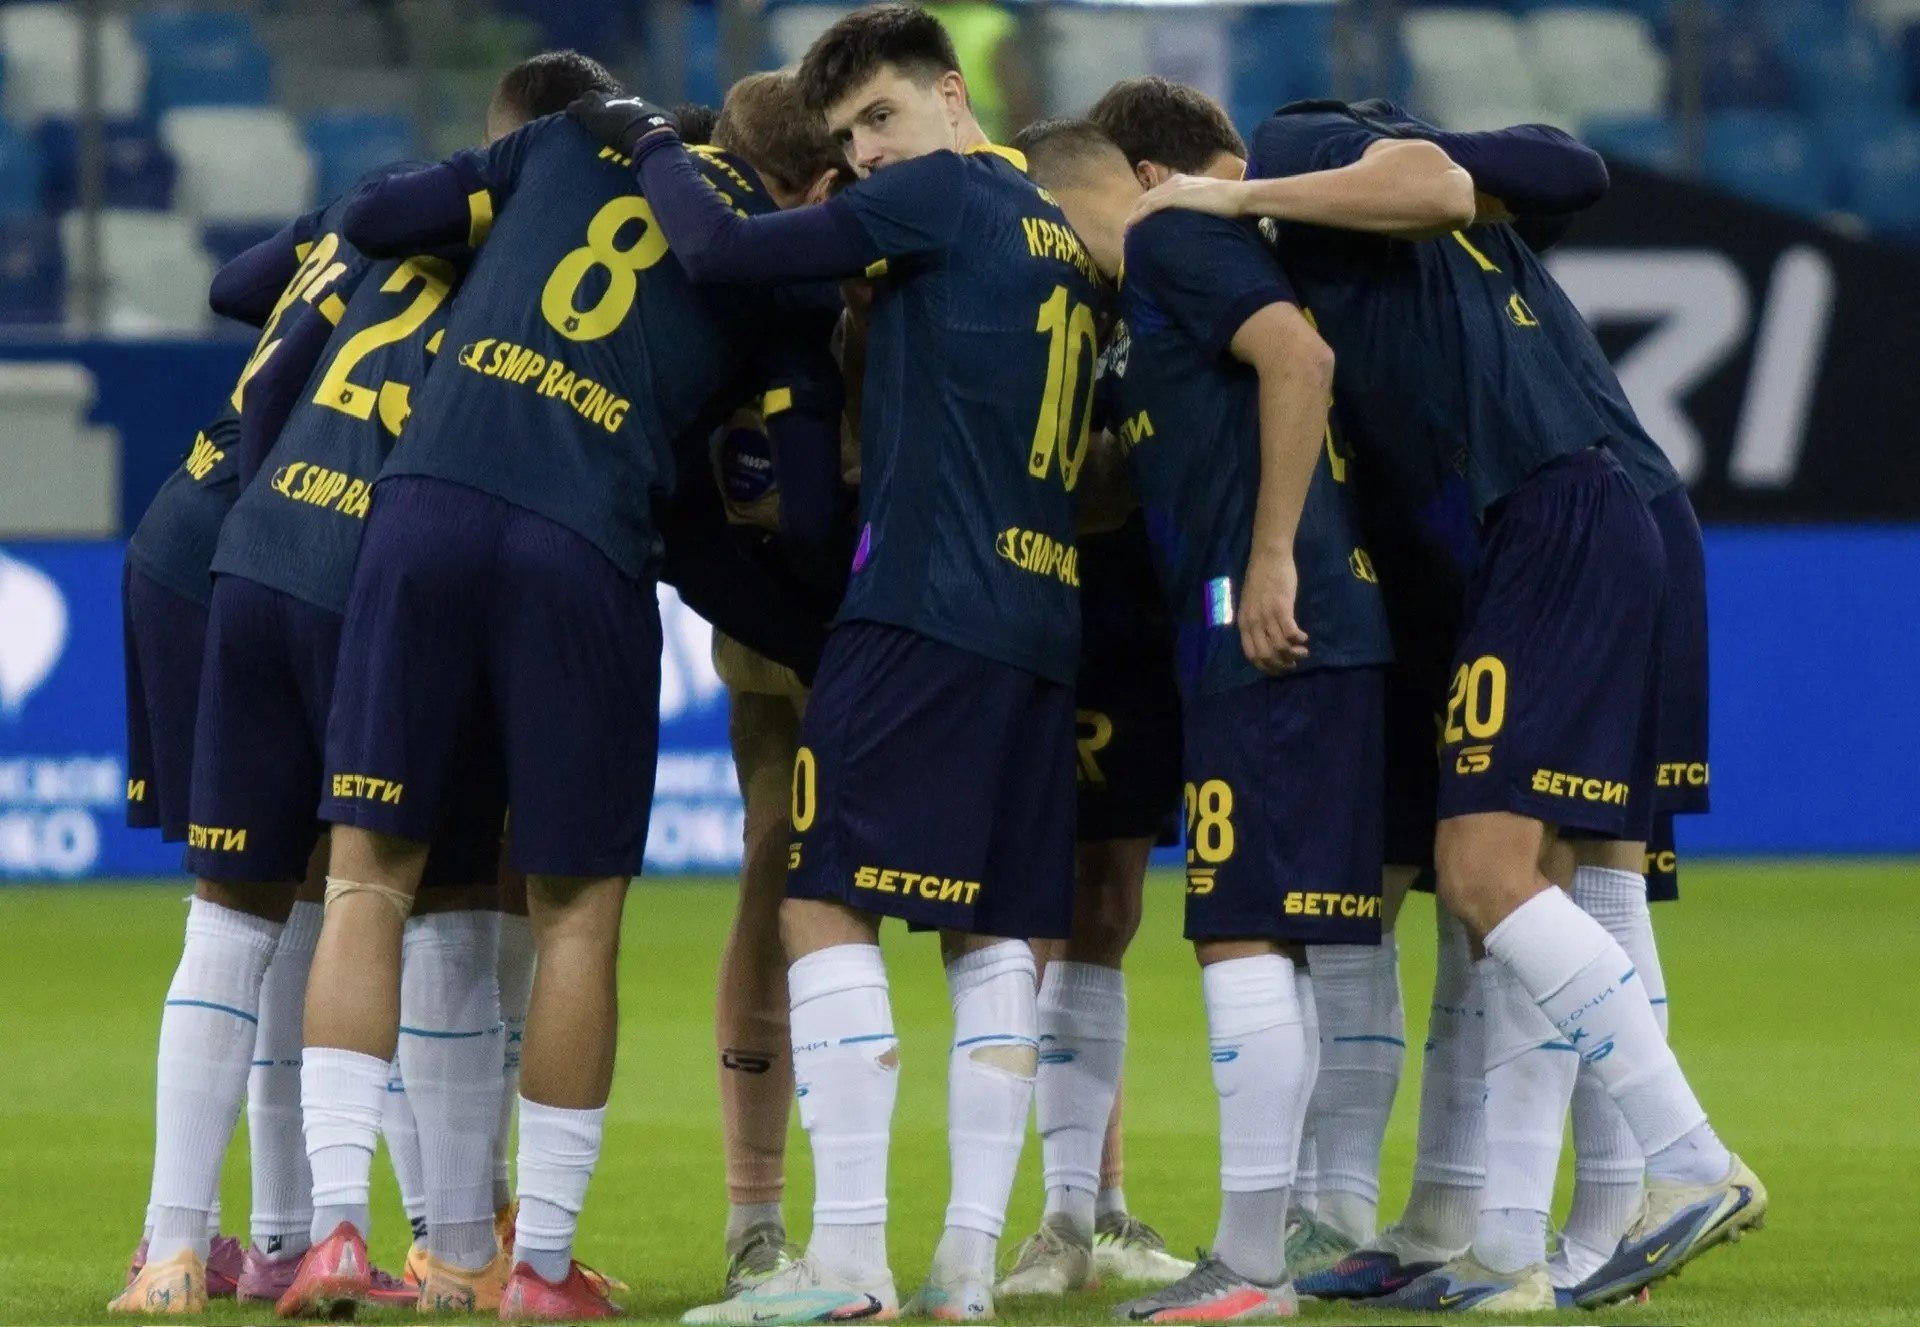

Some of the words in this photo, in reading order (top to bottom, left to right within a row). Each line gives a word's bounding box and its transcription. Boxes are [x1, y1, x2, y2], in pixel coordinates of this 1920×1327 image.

[541, 195, 669, 341] 8
[483, 340, 546, 385] SMP
[536, 359, 631, 433] RACING
[1028, 284, 1098, 492] 10
[292, 464, 348, 508] SMP
[1444, 655, 1506, 744] 20
[853, 865, 981, 905] БЕТСИТ
